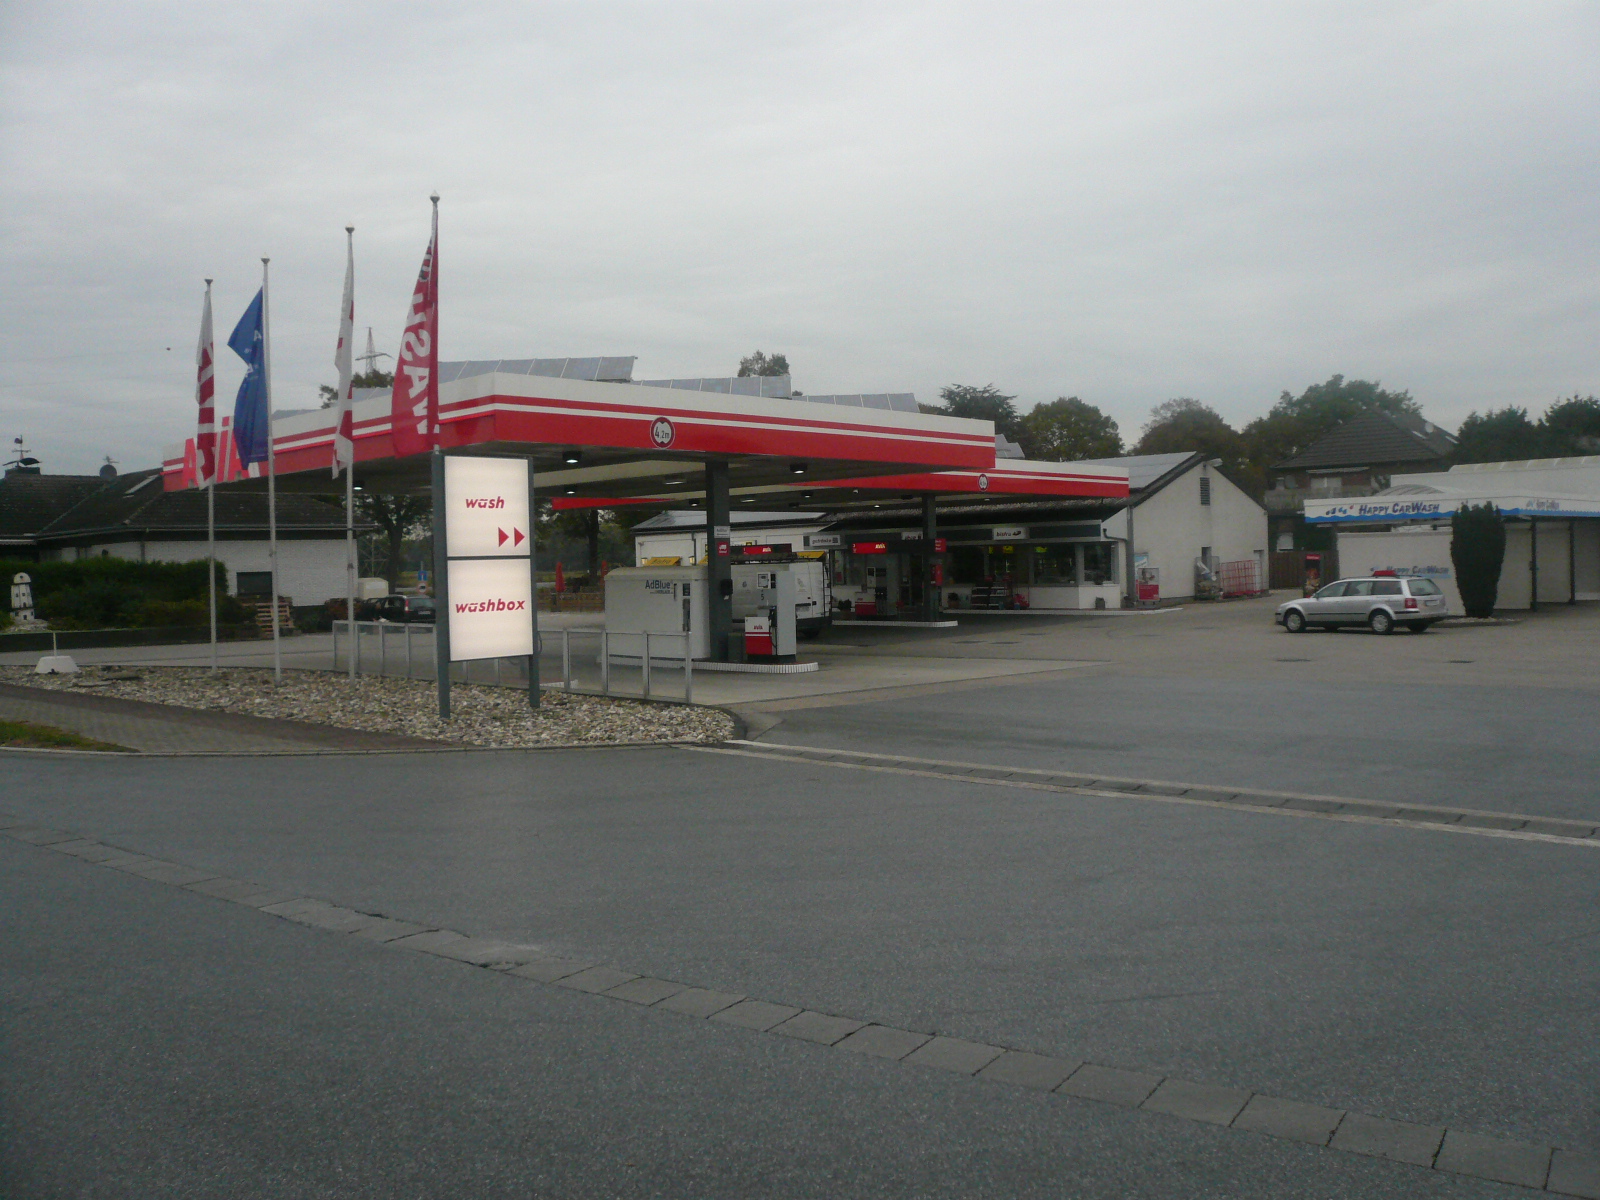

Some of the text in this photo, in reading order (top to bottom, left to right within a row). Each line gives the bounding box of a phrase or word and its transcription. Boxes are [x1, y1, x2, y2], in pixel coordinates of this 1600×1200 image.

[465, 495, 505, 510] wash
[1358, 503, 1390, 515] HAPPY
[644, 579, 671, 590] AdBlue
[760, 593, 766, 601] 5
[455, 597, 526, 615] washbox
